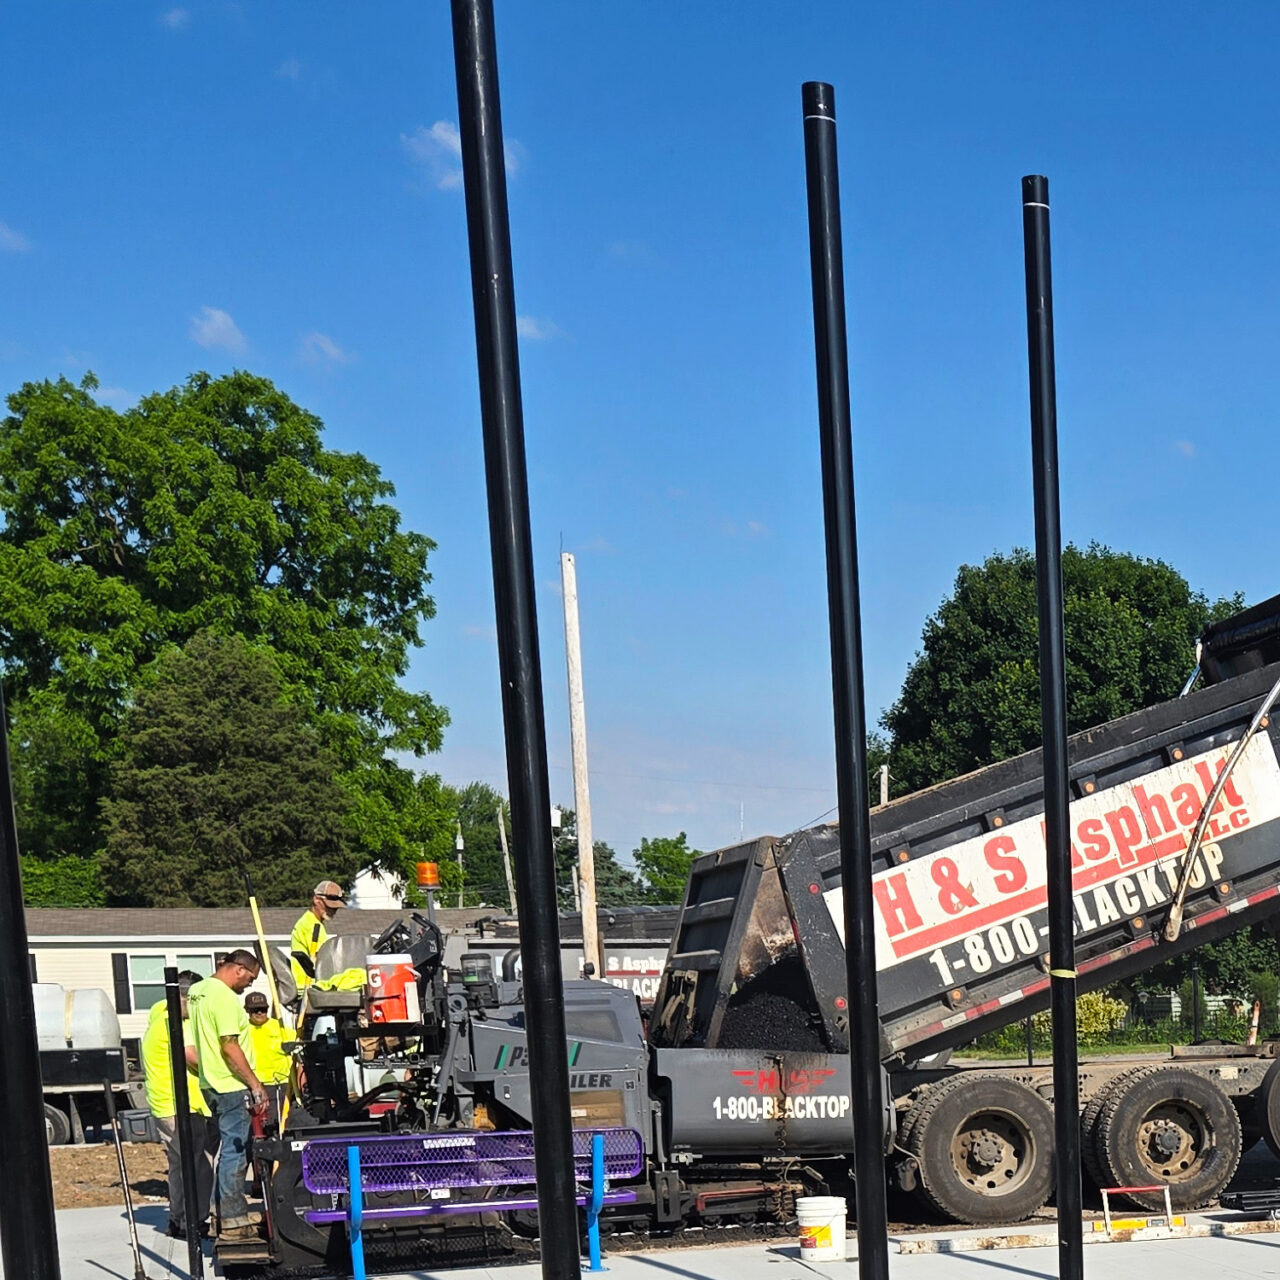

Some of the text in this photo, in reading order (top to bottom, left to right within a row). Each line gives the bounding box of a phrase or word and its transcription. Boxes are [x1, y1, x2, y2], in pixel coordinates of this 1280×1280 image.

[873, 872, 924, 938] H
[931, 857, 980, 915] &
[984, 836, 1028, 894] S
[928, 843, 1224, 986] 1-800-LACKTOP
[368, 968, 382, 988] G
